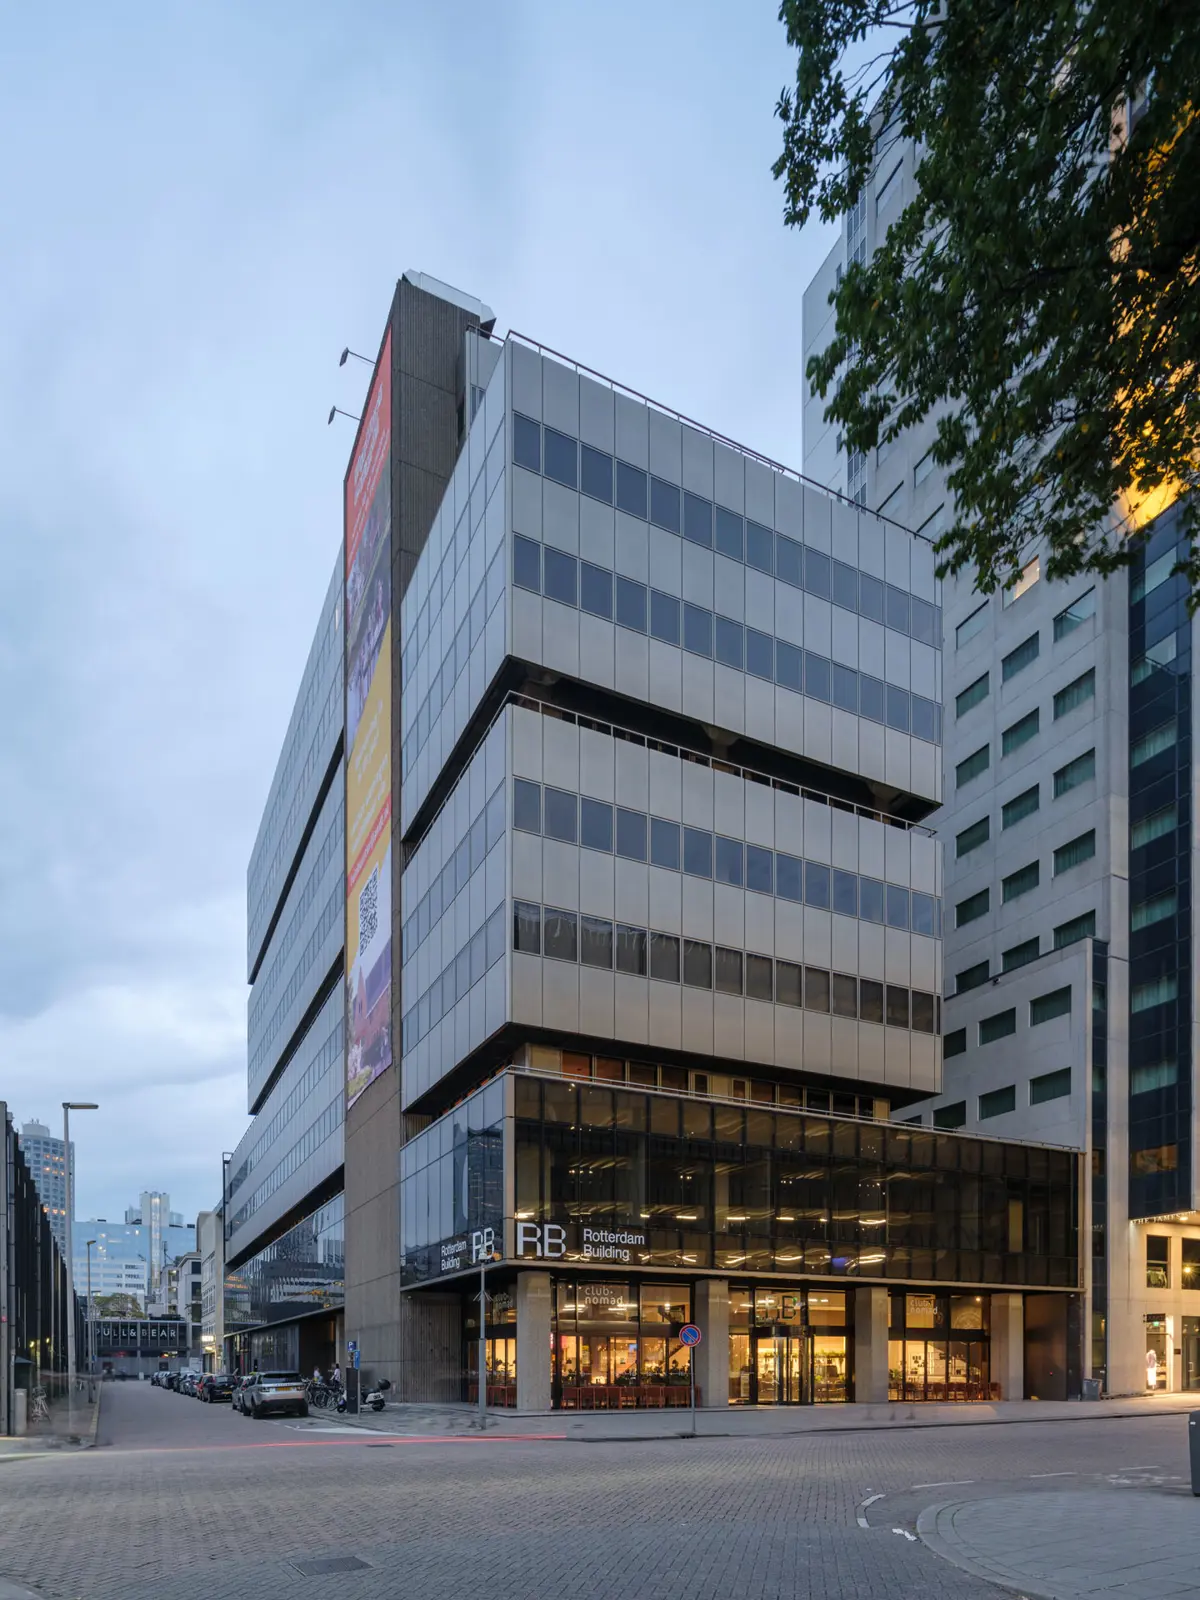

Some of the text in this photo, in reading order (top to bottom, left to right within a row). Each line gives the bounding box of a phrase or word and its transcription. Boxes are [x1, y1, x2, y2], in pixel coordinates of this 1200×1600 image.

[516, 1222, 567, 1257] RB
[583, 1228, 645, 1245] Rotterdam
[441, 1240, 467, 1257] Rotterdam
[583, 1244, 630, 1261] Building
[441, 1256, 460, 1271] Building
[584, 1296, 624, 1306] nomad
